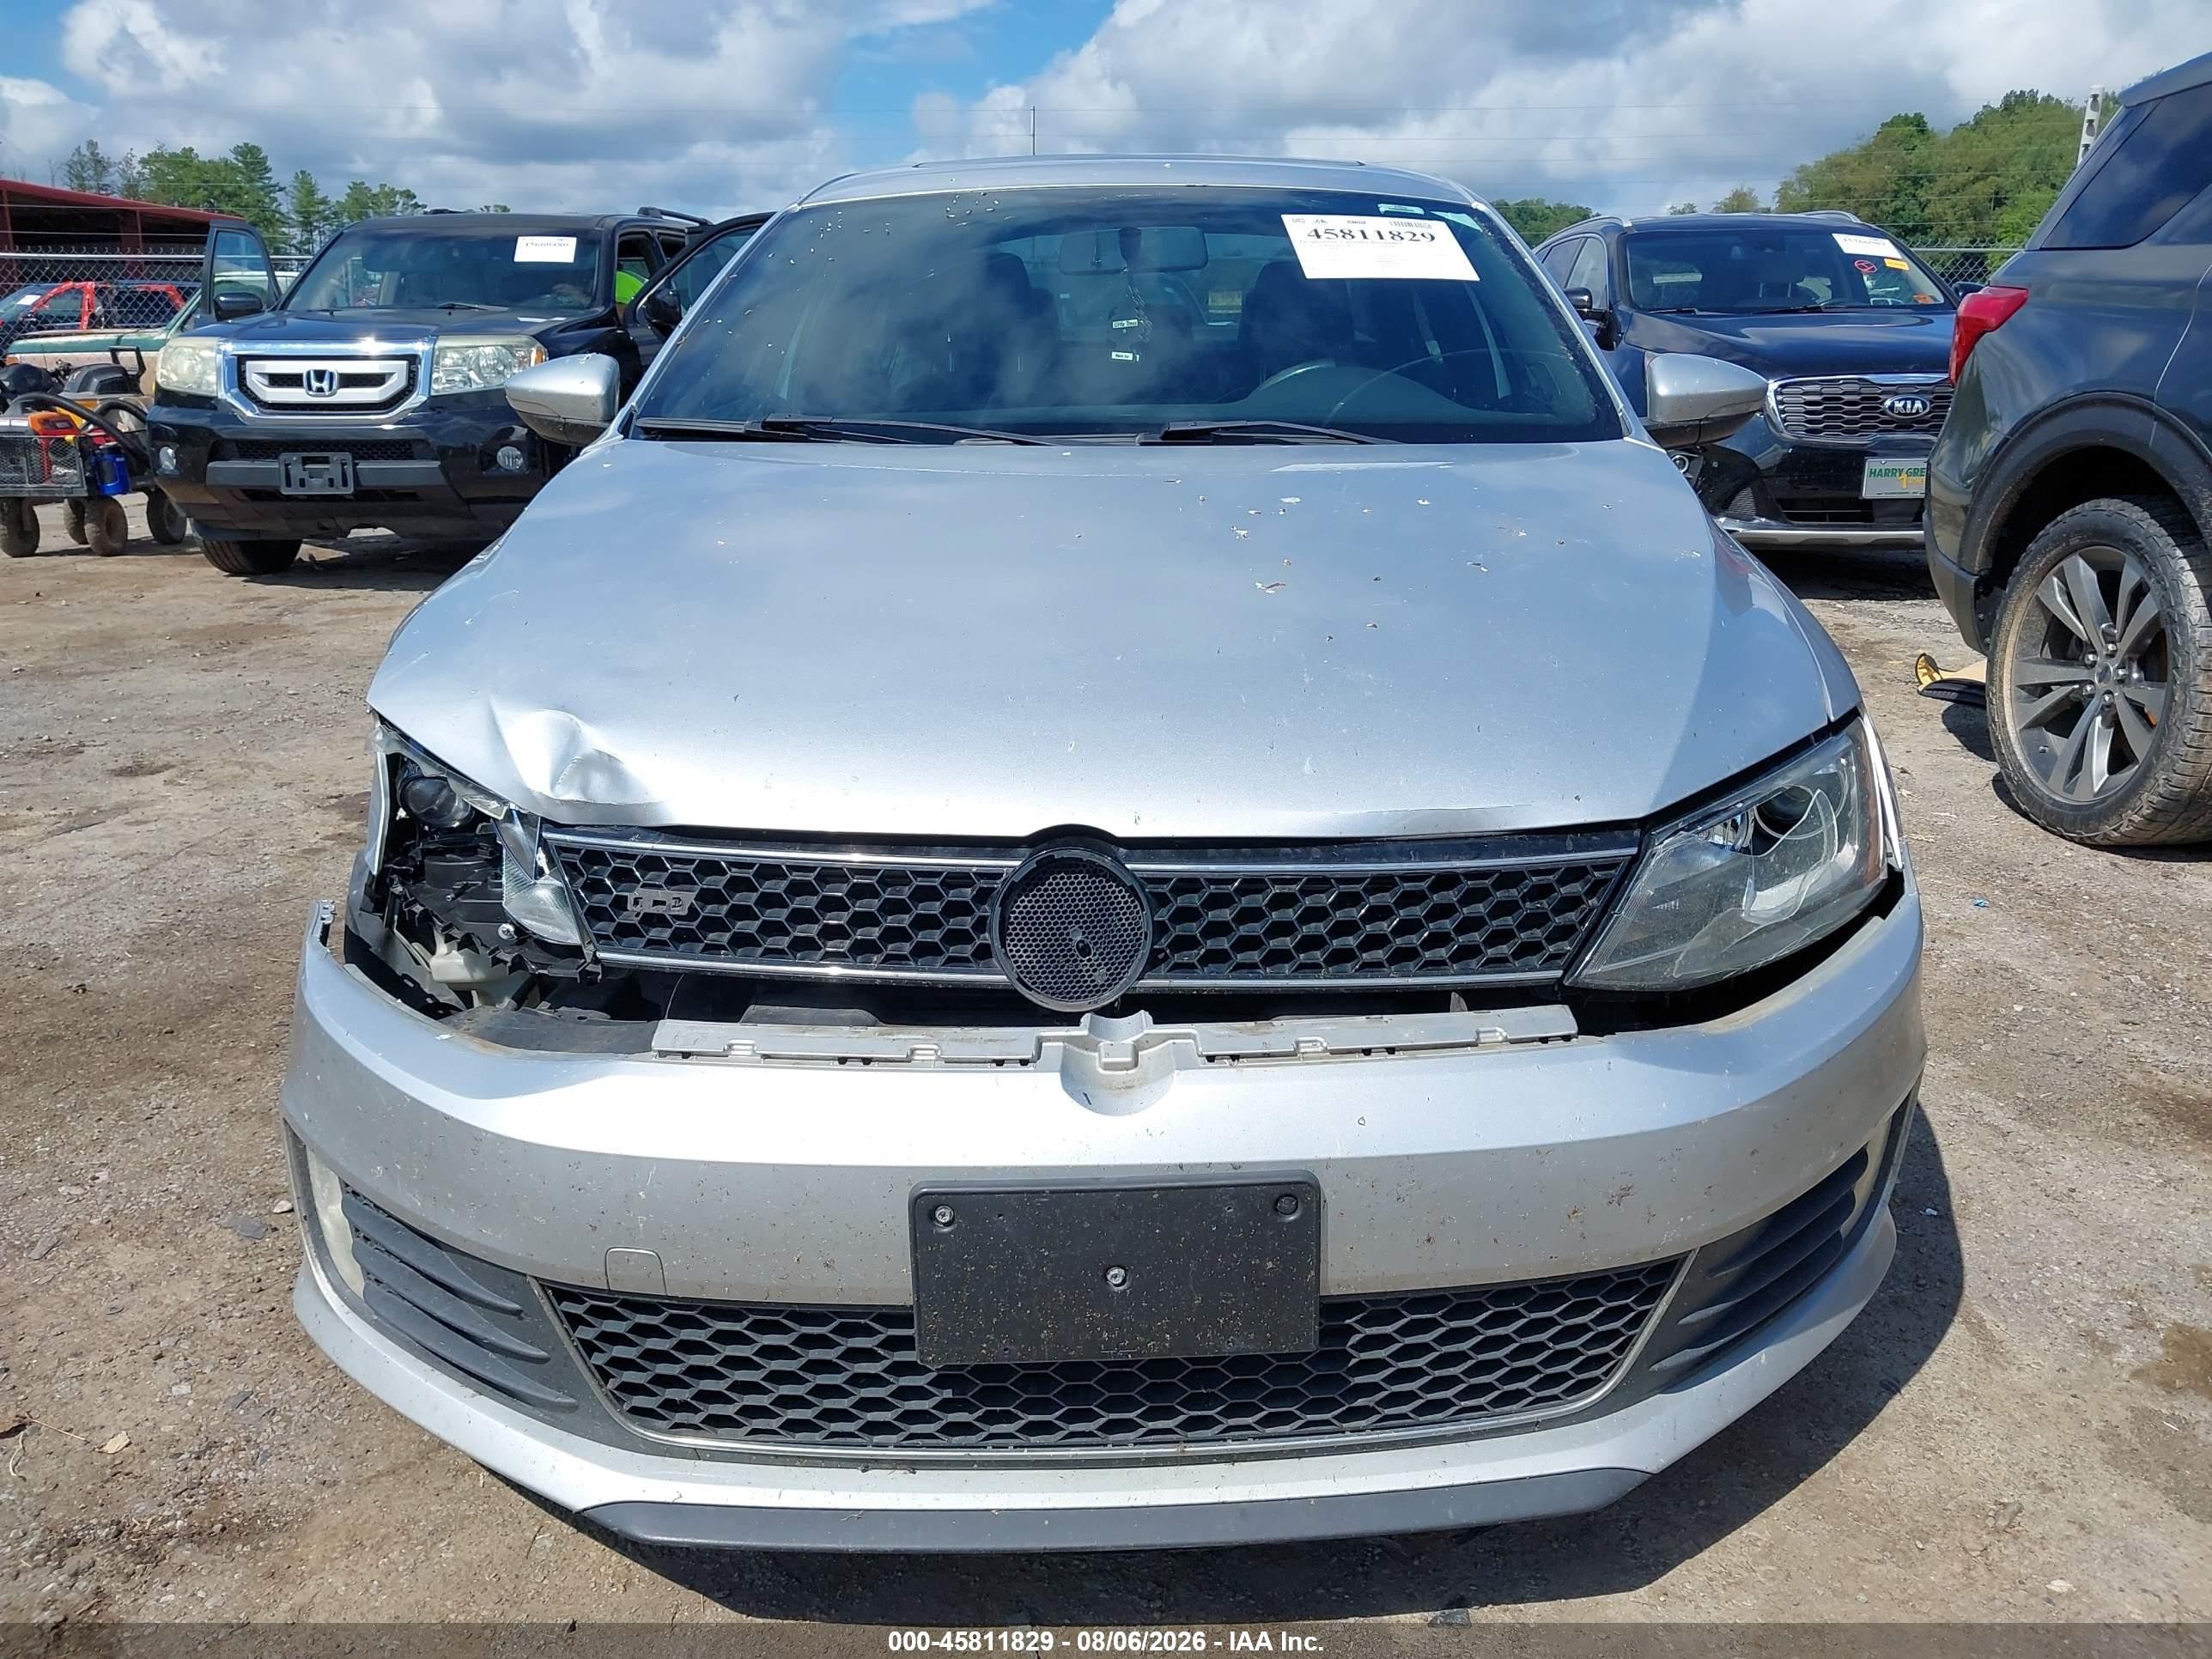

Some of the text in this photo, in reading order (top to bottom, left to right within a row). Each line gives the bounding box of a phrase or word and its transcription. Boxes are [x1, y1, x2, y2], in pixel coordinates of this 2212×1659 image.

[1307, 228, 1436, 243] 45811829
[1893, 400, 1923, 413] KIA
[1869, 467, 1926, 478] HARRY GRE
